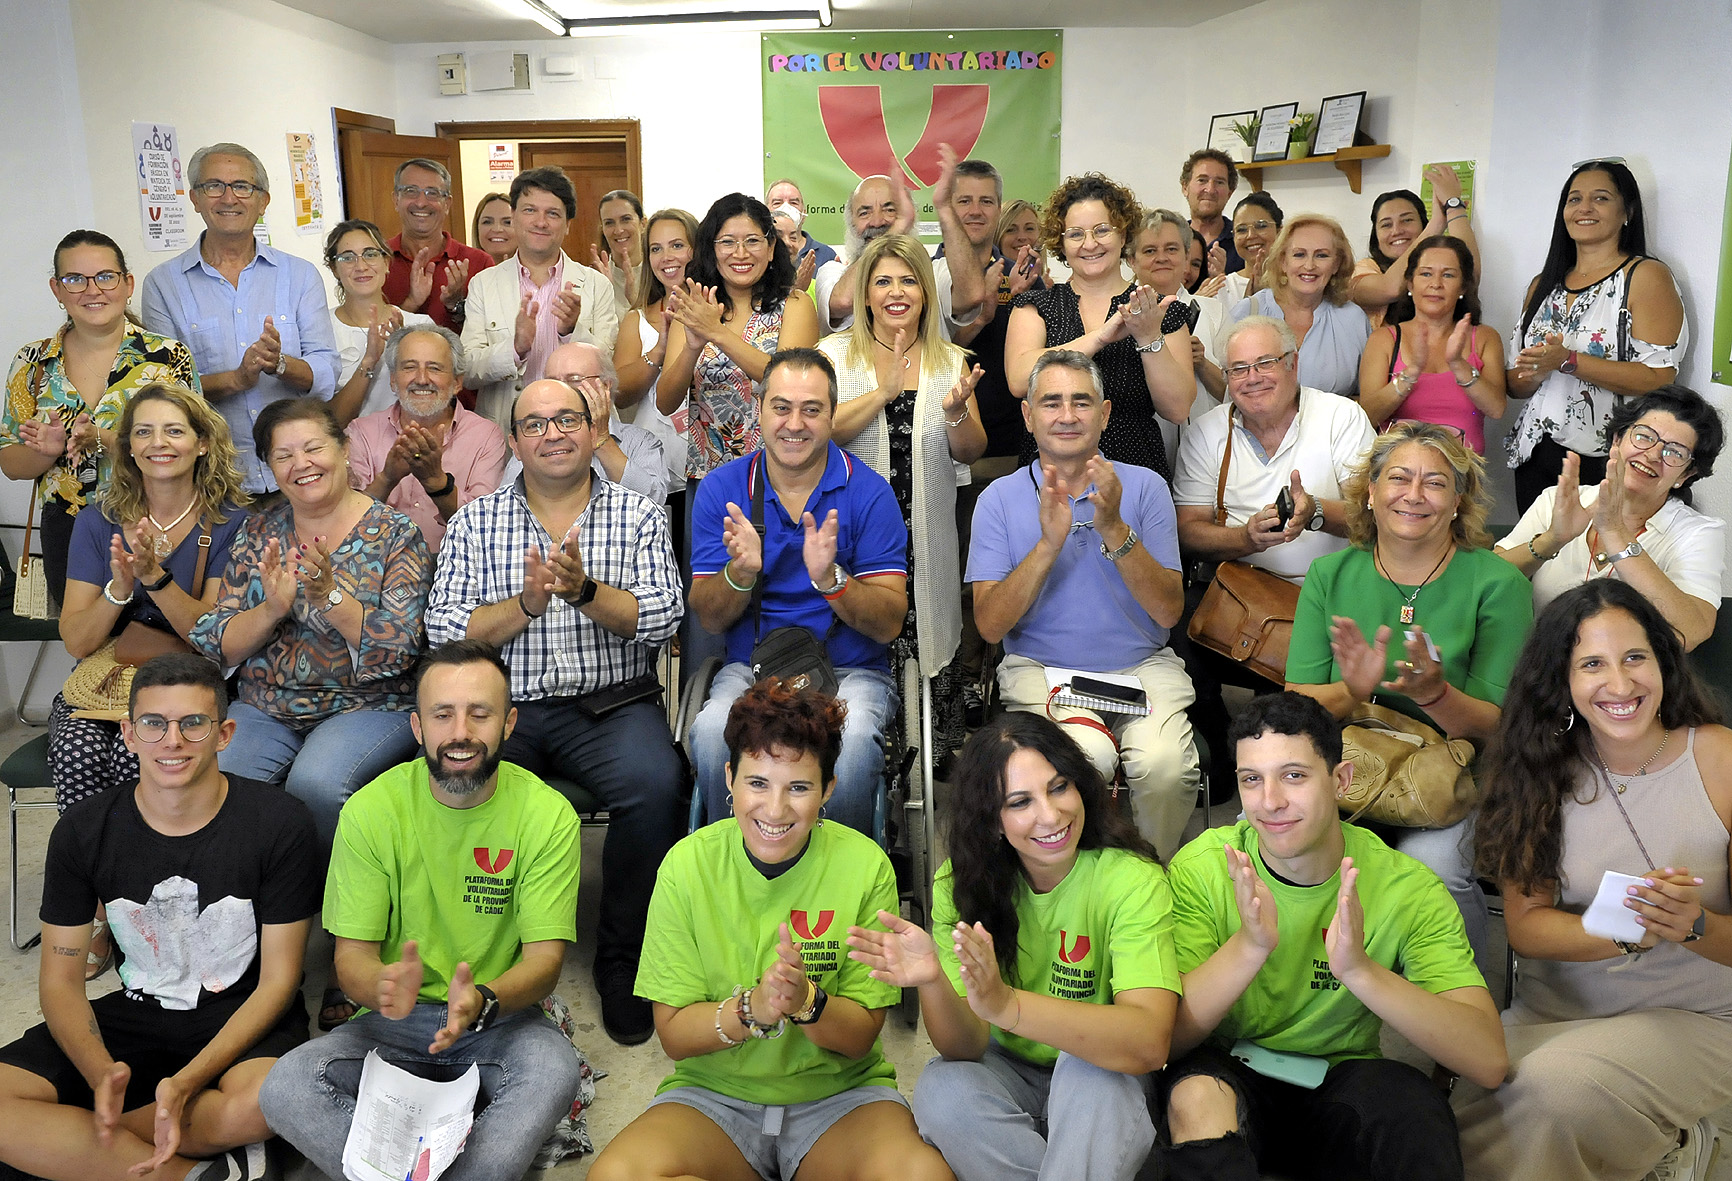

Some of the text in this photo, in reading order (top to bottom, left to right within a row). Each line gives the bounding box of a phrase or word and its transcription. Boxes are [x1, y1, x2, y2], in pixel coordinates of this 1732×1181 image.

[768, 51, 1056, 72] POR EL VOLUNTARIADO
[490, 160, 514, 168] Alarma
[806, 204, 836, 213] forma
[922, 203, 934, 213] de
[464, 876, 514, 886] PLATAFORMA DE
[473, 895, 481, 903] LA
[474, 905, 483, 913] DE
[800, 941, 840, 950] FORMA DEL
[800, 952, 837, 961] NTARIADO
[805, 963, 838, 972] ROVINCIA
[807, 973, 823, 982] ÁDIZ
[1083, 969, 1096, 978] DEL
[1056, 987, 1096, 999] PROVINCIA
